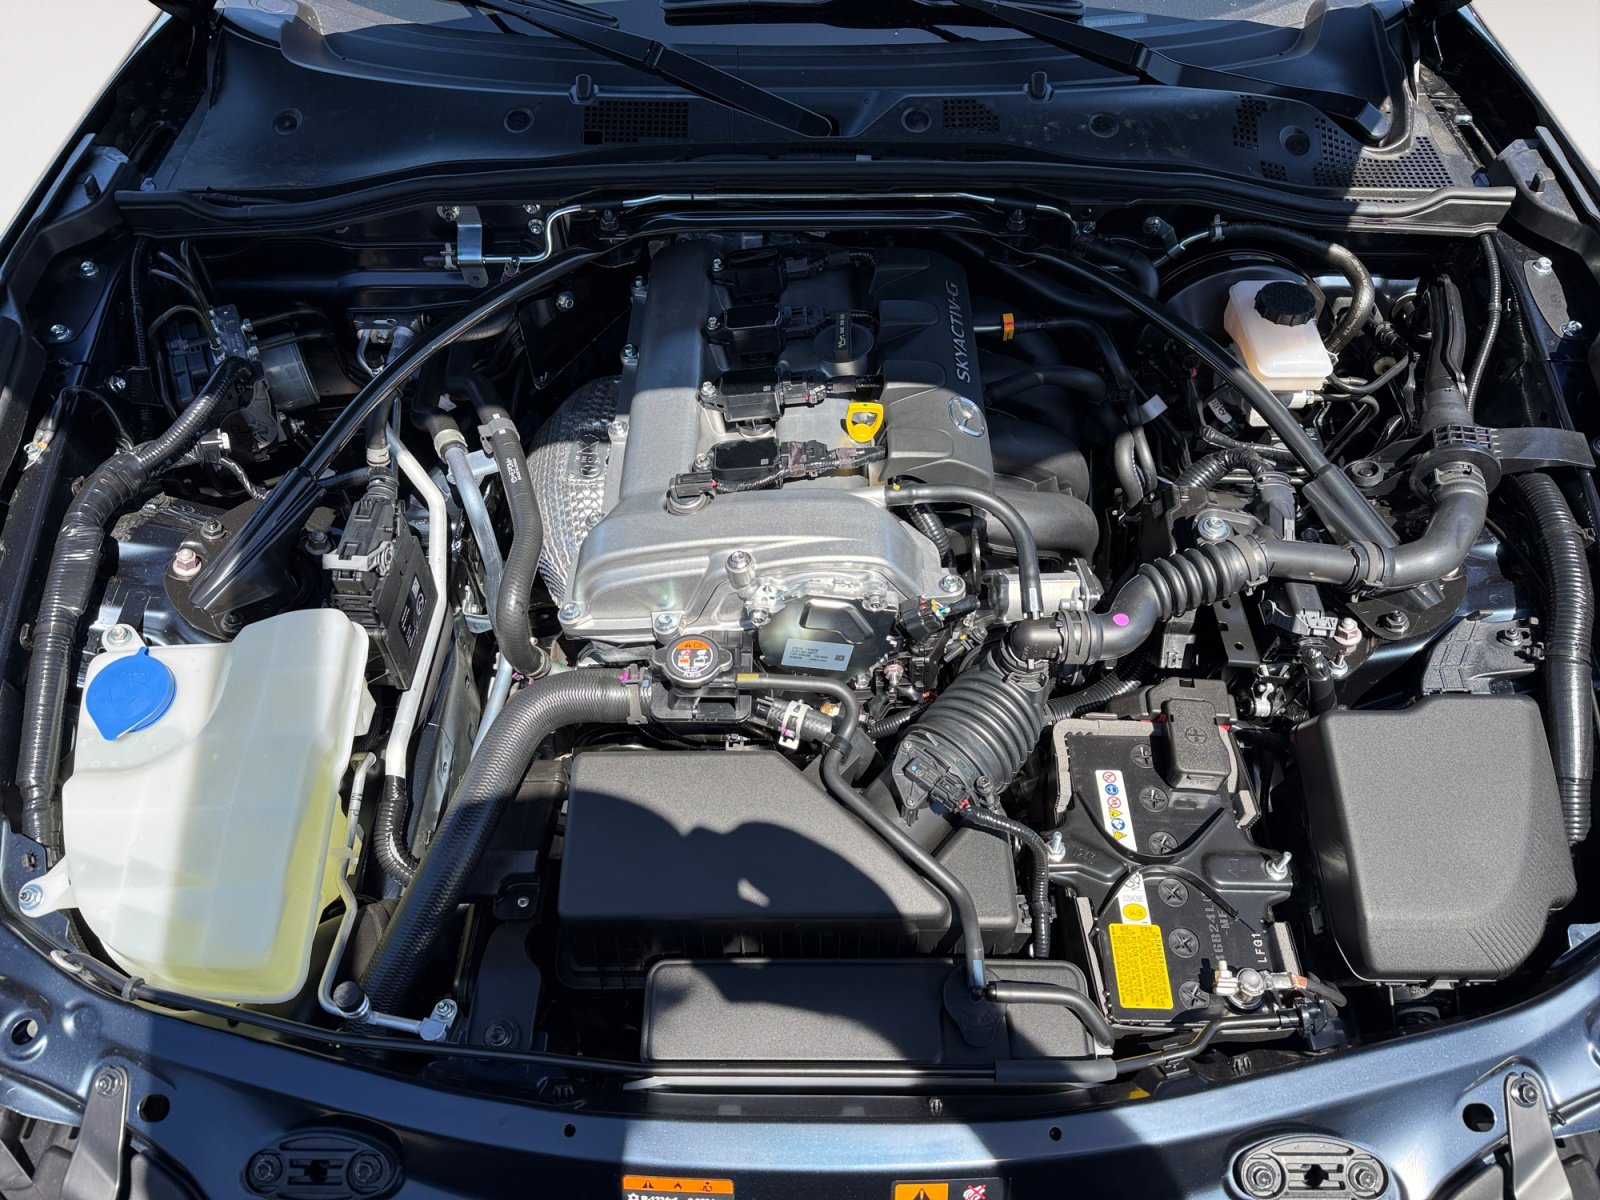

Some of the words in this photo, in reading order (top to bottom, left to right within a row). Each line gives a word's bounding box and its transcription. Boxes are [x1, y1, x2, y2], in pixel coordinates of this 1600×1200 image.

[945, 280, 971, 384] SKYACTIV-G
[1129, 936, 1139, 956] POISON
[1154, 939, 1164, 963] DANGER
[1251, 933, 1268, 963] LFG1
